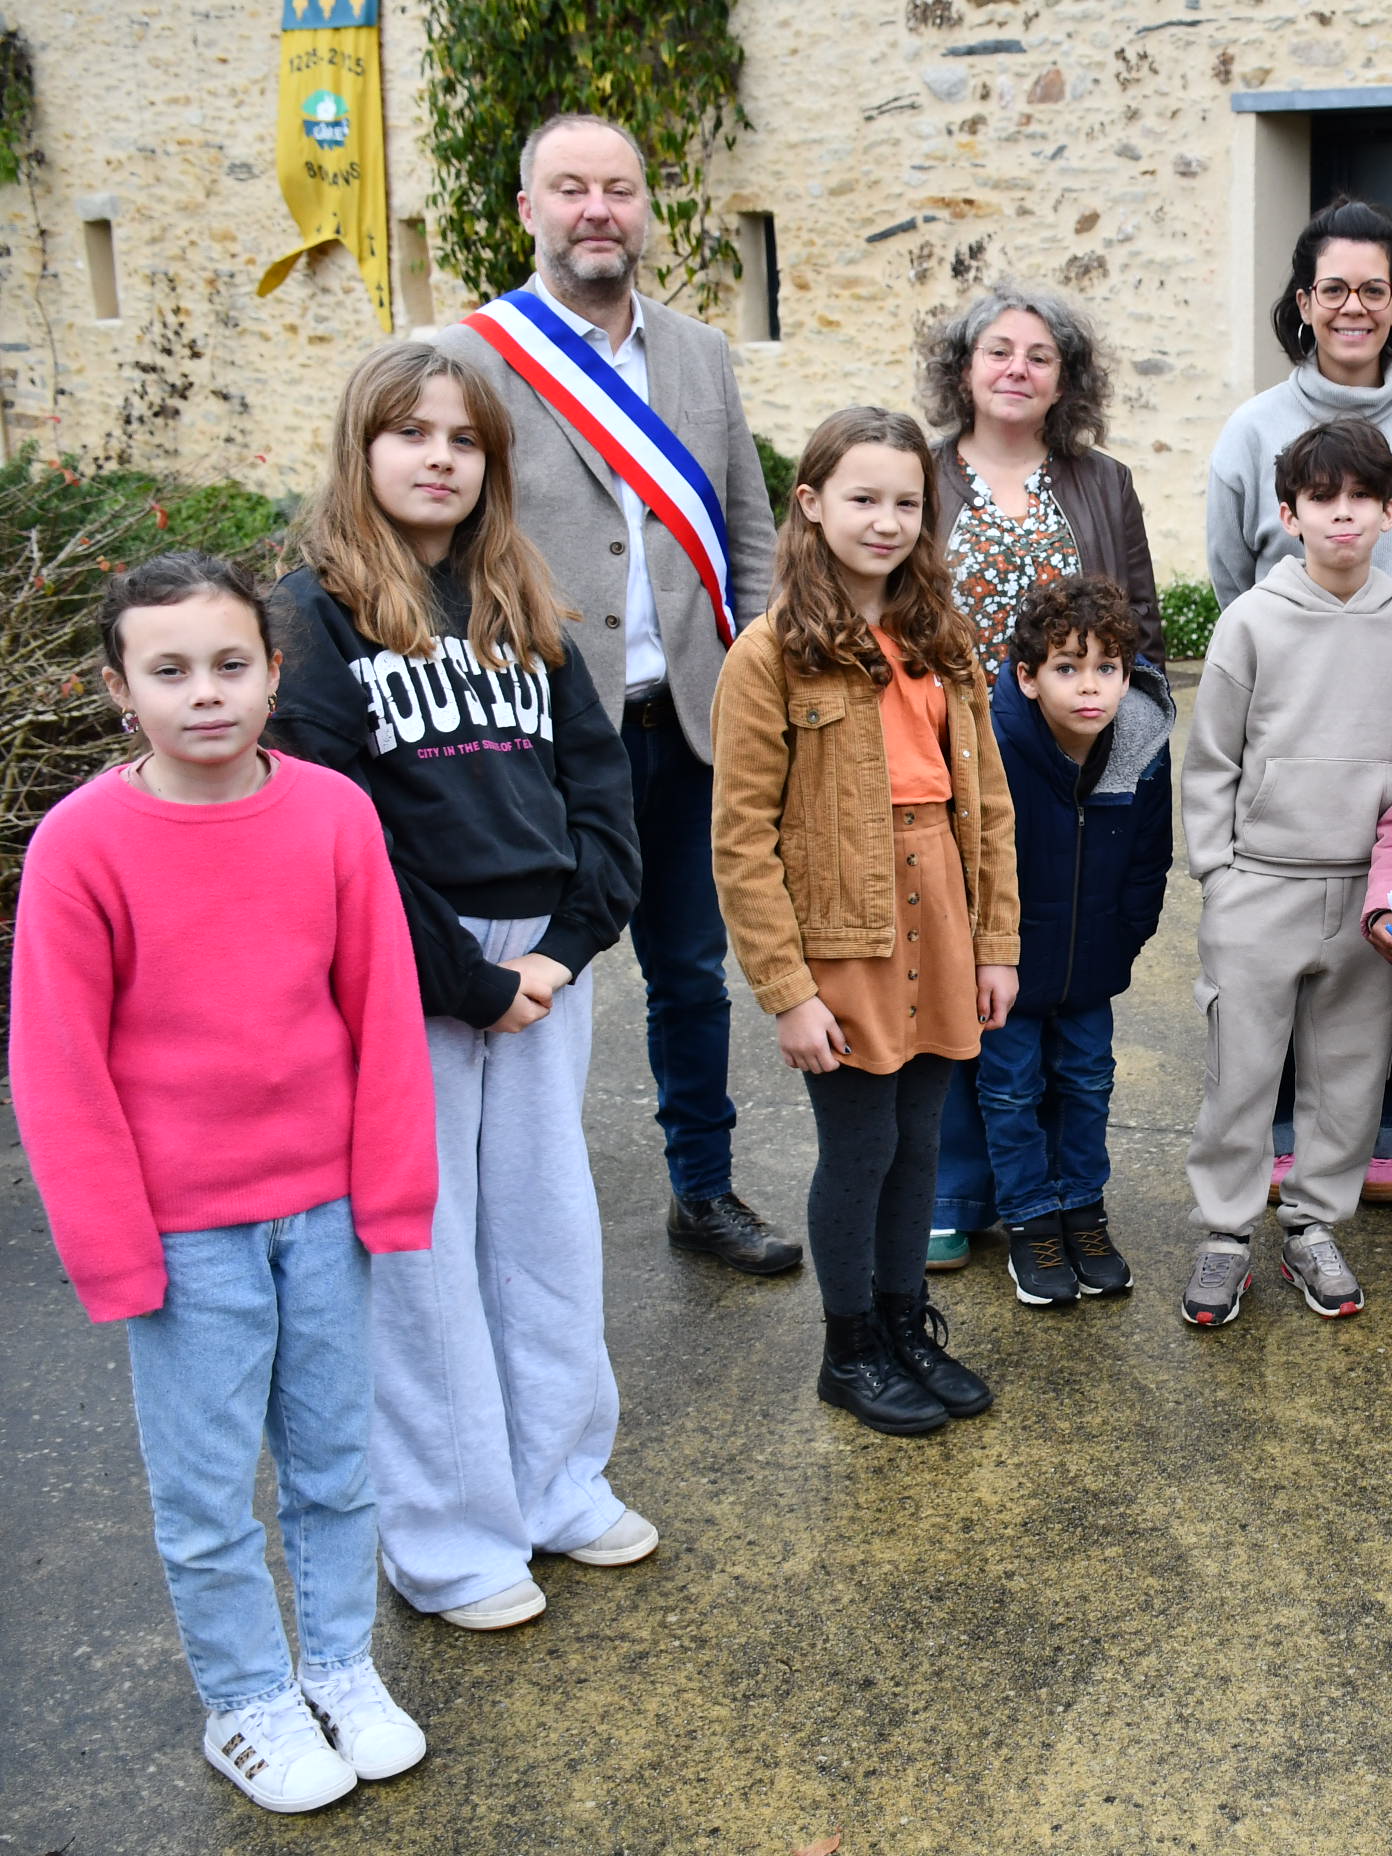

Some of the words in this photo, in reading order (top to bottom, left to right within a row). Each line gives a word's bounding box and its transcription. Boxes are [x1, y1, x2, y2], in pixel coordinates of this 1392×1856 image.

[417, 748, 440, 759] CITY
[443, 746, 456, 757] IN
[457, 741, 480, 755] THE
[500, 741, 513, 751] OF
